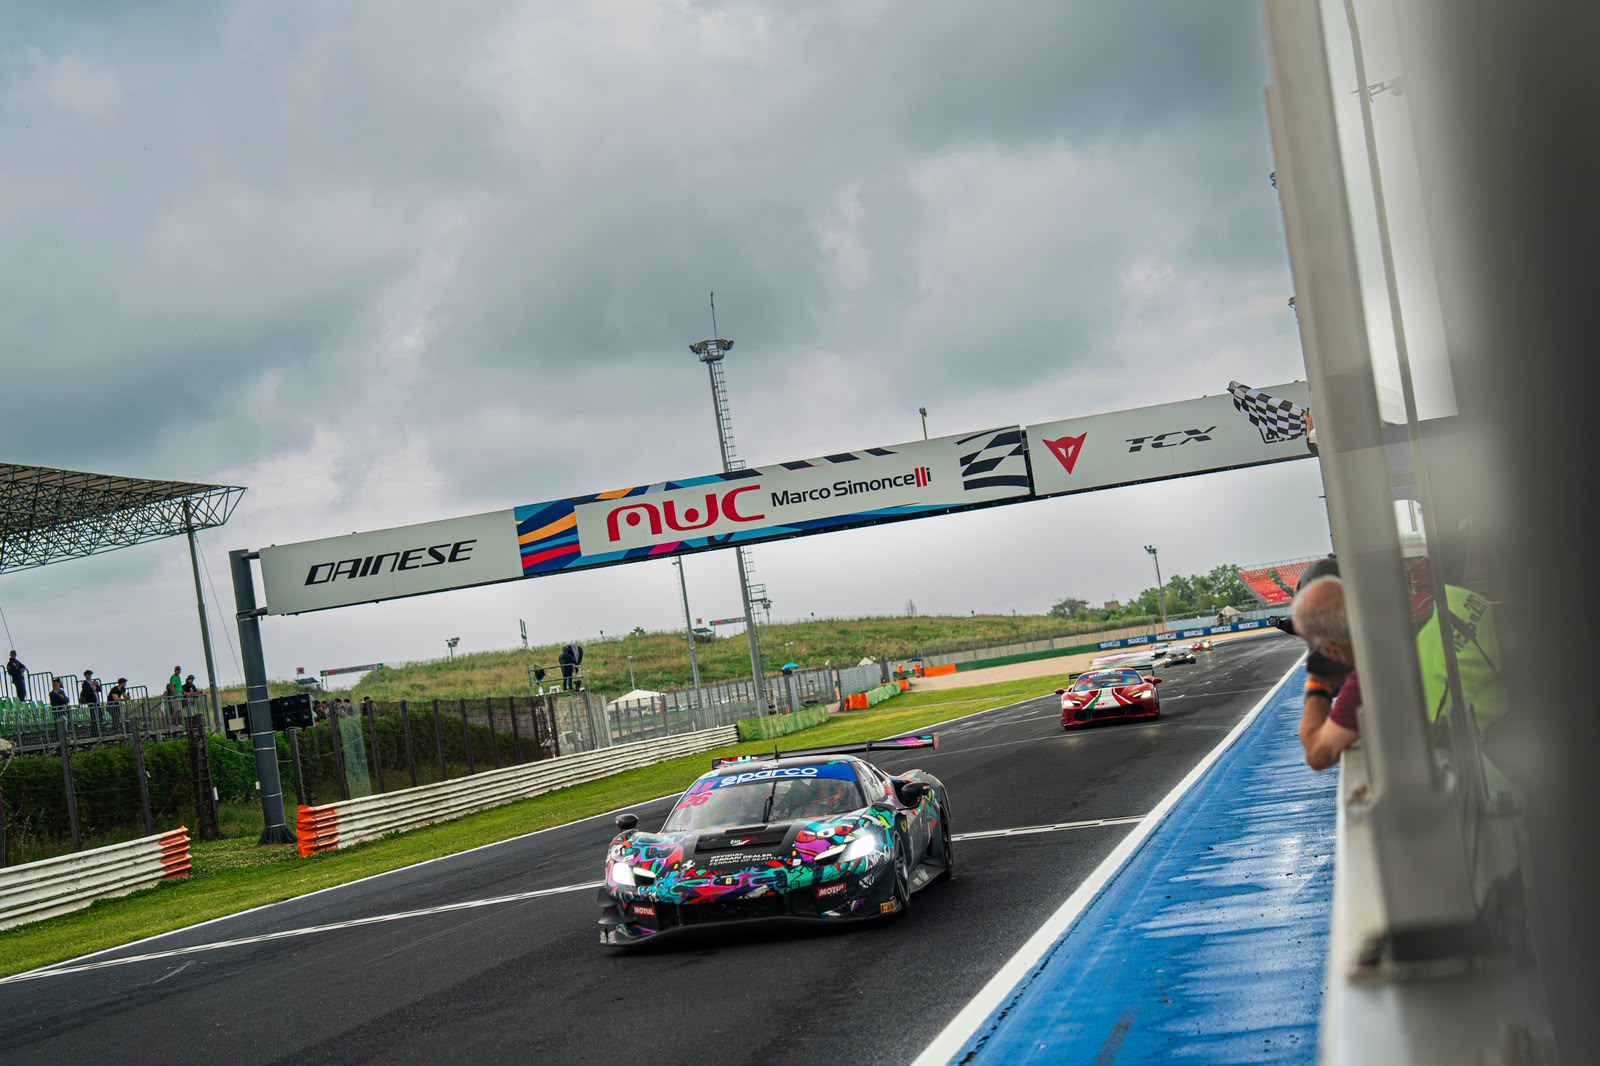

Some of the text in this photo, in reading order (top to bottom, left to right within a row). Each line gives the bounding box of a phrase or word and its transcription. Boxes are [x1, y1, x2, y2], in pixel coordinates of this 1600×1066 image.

[1125, 425, 1217, 453] TCX
[771, 466, 932, 508] Marco Simoncelli
[304, 539, 478, 586] DAINESE
[720, 767, 818, 787] sparco
[710, 852, 744, 860] OFFICIAL
[819, 884, 845, 897] MOTUL
[633, 906, 655, 915] MOTUL
